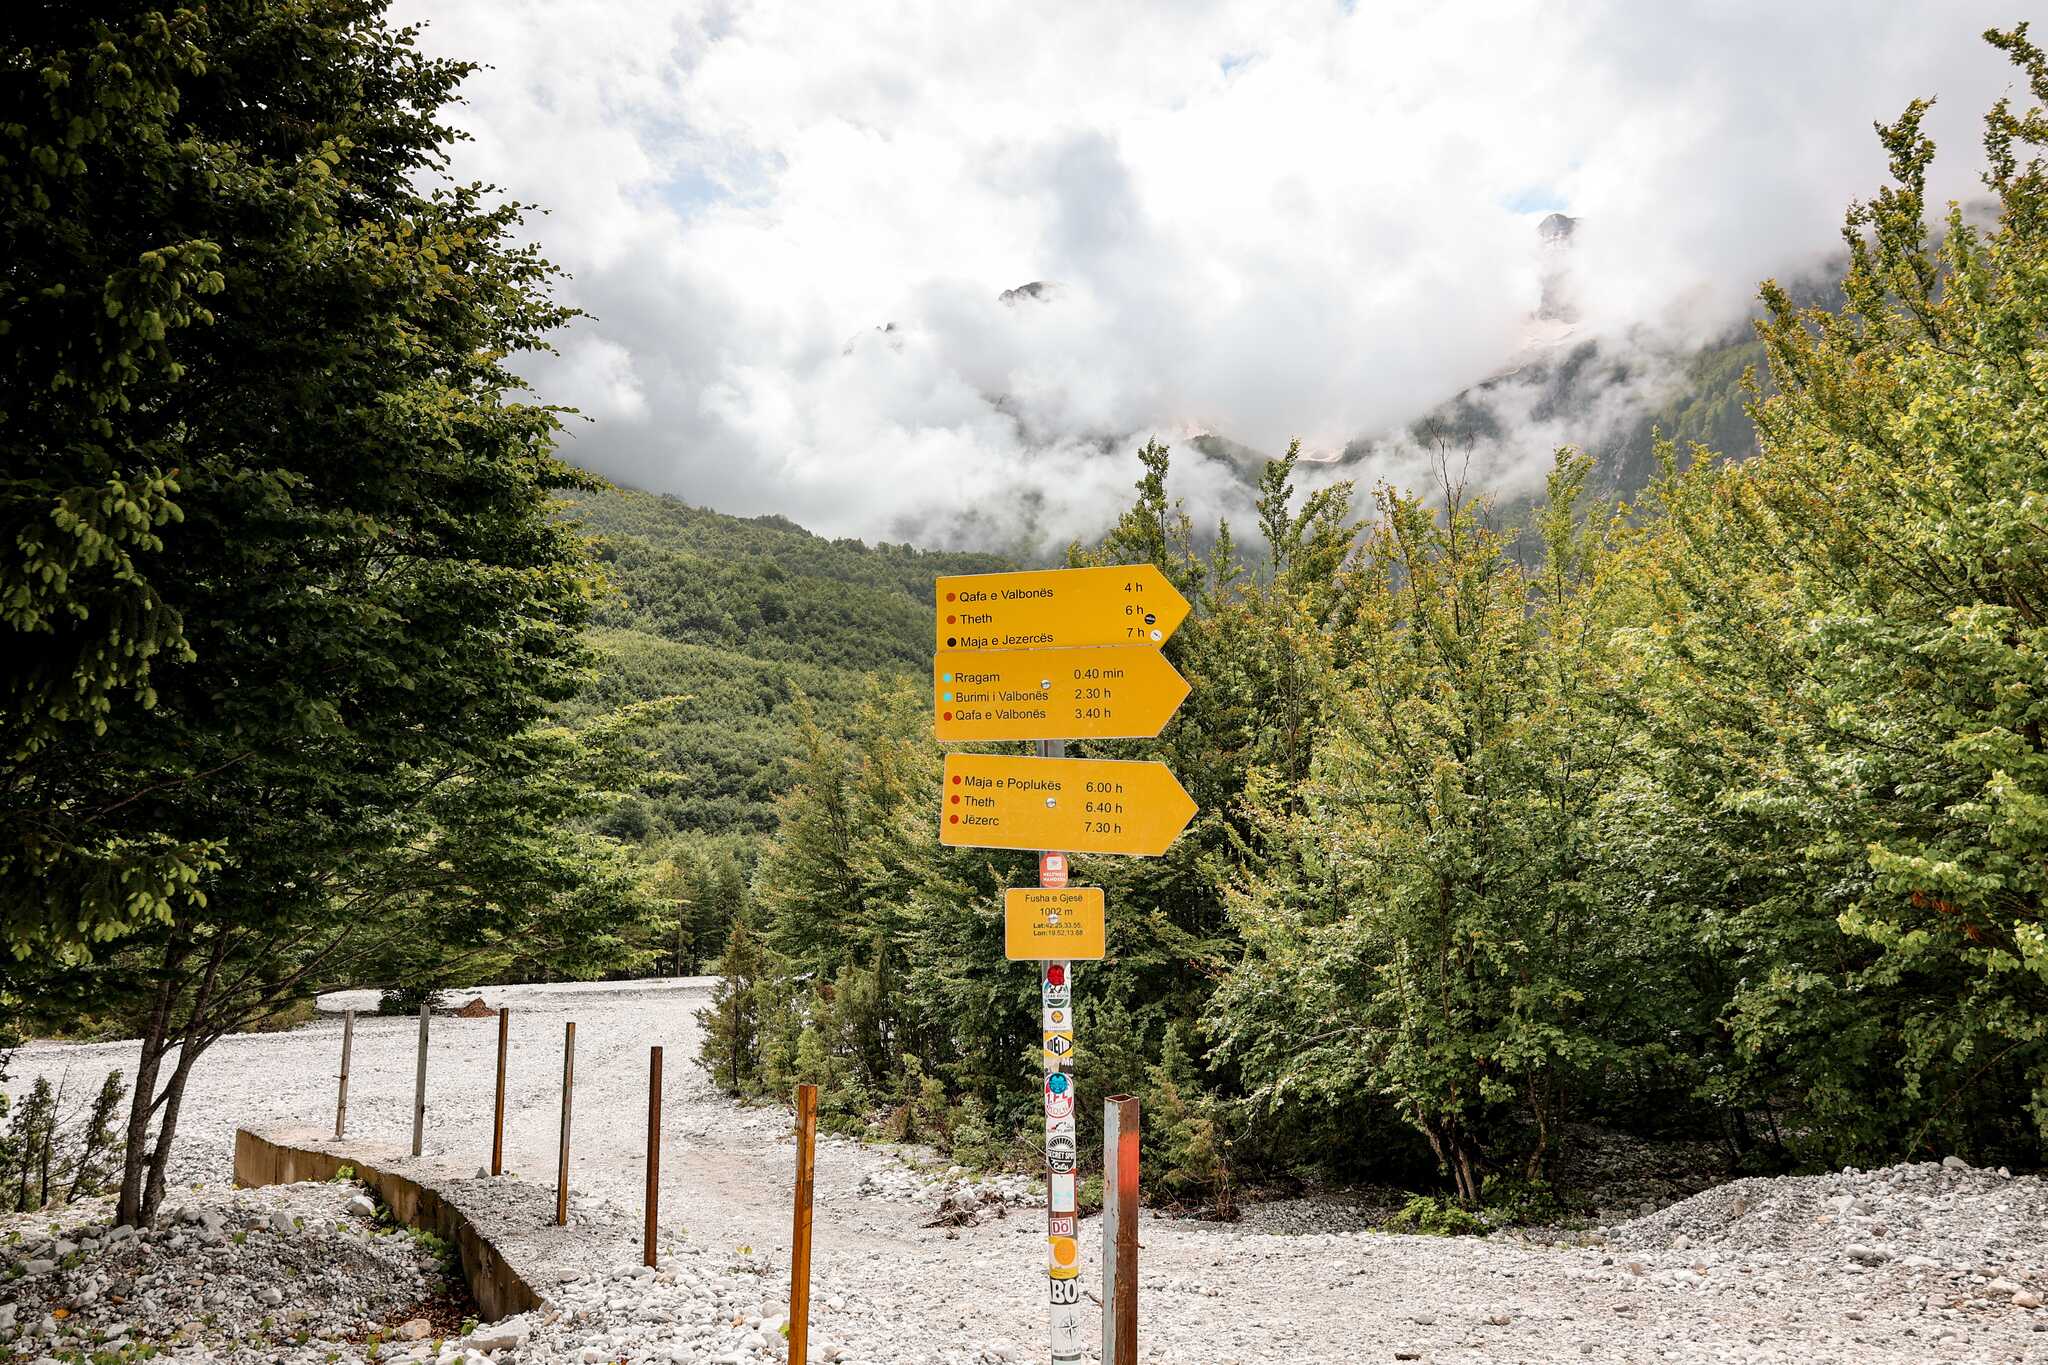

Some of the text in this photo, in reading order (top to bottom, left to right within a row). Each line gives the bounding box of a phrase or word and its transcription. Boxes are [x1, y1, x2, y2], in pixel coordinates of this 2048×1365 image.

[960, 591, 988, 602] Qafa
[1001, 588, 1054, 600] Valbonës
[1125, 583, 1132, 592] 4
[1136, 582, 1142, 592] h
[960, 605, 1143, 624] Theth 6 h
[961, 636, 988, 649] Maja
[1002, 633, 1053, 645] Jezercës
[1127, 628, 1133, 637] 7
[1138, 628, 1144, 637] h
[955, 668, 1123, 685] Rragam 0.40 min
[956, 688, 1111, 702] Burimi i Valbonës 2.30 h
[956, 708, 1111, 720] Qafa e Valbonës 3.40 h
[965, 776, 992, 789] Maja
[997, 780, 1003, 788] e
[1086, 782, 1111, 793] 6.00
[1116, 784, 1122, 793] h
[964, 796, 1122, 813] Theth 6.40 h
[1085, 822, 1110, 833] 7.30
[1114, 824, 1121, 833] h
[1040, 908, 1062, 916] 1002
[1051, 1279, 1078, 1303] BO
